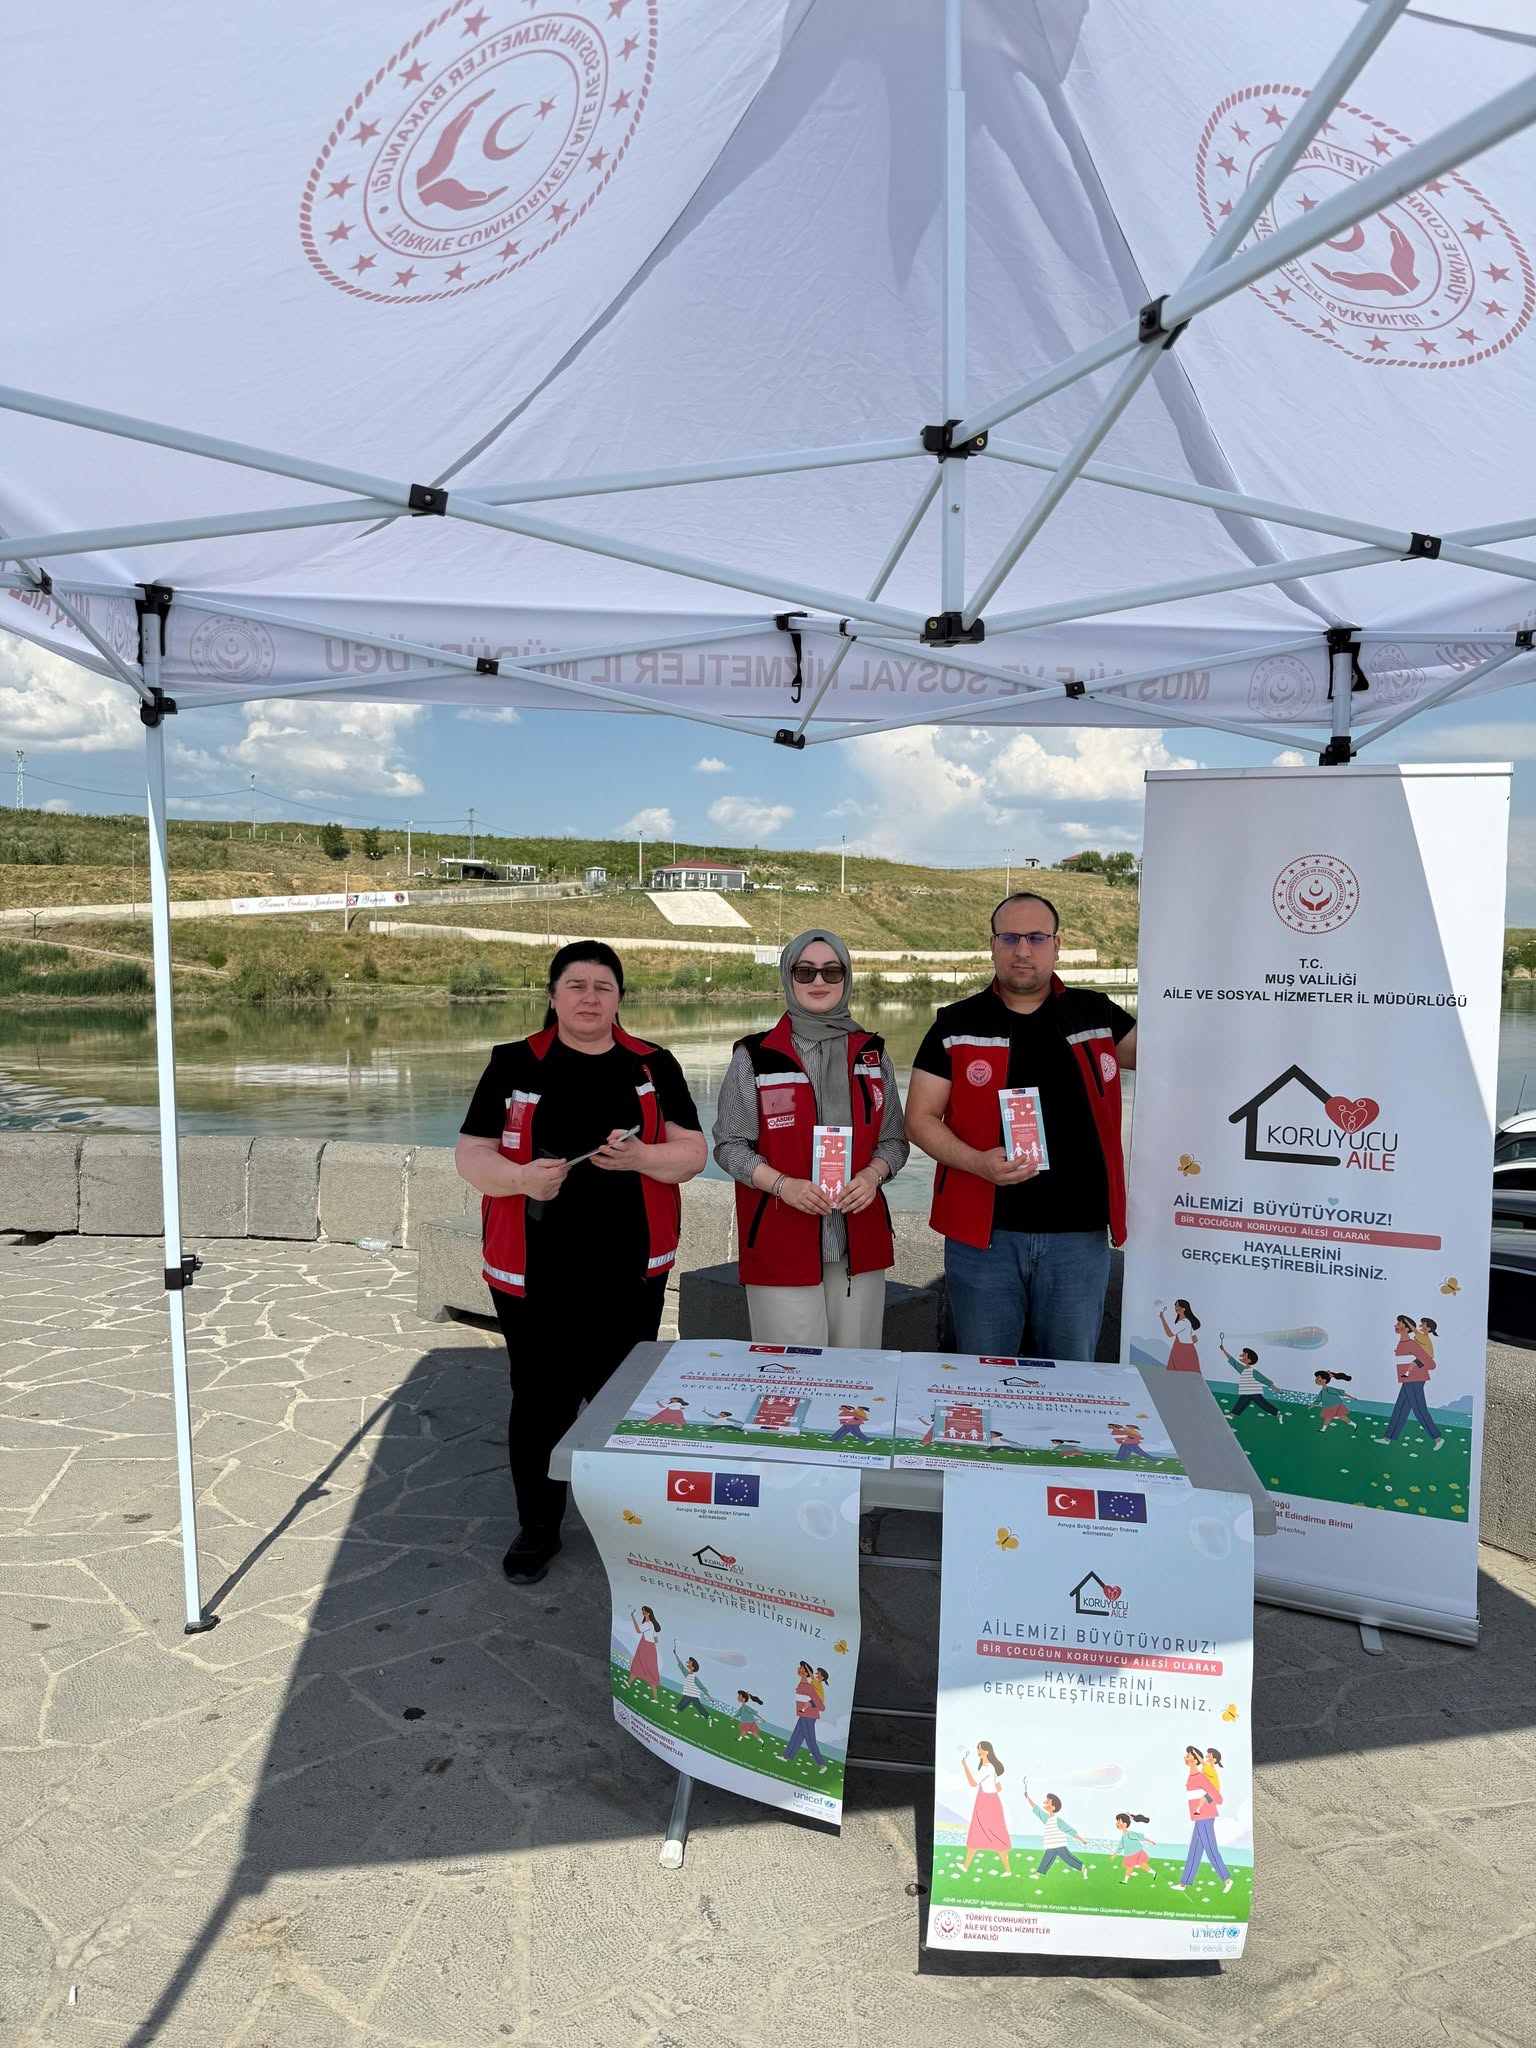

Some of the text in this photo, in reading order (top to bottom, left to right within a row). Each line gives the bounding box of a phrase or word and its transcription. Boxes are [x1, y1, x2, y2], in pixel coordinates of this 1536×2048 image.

[1299, 958, 1323, 970] T.C.
[1265, 972, 1357, 987] MUŞ VALİLİĞİ
[1163, 988, 1468, 1008] AİLE VE SOSYAL HİZMETLER İL MÜDÜRLÜĞÜ
[1267, 1125, 1399, 1152] KORUYUCU
[1346, 1147, 1396, 1172] AİLE
[1173, 1192, 1393, 1227] AİLEMİZİ BÜYÜTÜYORUZ!
[1180, 1214, 1370, 1241] BİR ÇOCUĞUN KORUYUCU AİLESİ OLARAK
[1243, 1240, 1342, 1262] HAYALLERİNİ
[1181, 1247, 1388, 1282] GERÇEKLEŞTİREBİLİRSİNİZ.
[1285, 1511, 1327, 1525] Edindirme
[1328, 1519, 1353, 1530] Birimi
[628, 1551, 827, 1606] AİLEMİZİ BÜYÜTÜYORUZ!
[686, 1582, 777, 1611] HAYALLERİNİ
[1083, 1597, 1128, 1610] KORUYUCU
[790, 1600, 830, 1615] OLARAK
[1111, 1608, 1128, 1619] AİLE
[982, 1619, 1217, 1654] AİLEMİZİ BÜYÜTÜYORUZ!
[983, 1642, 1217, 1673] BİR ÇOCUĞUN KORUYUCU AİLESİ OLARAK
[1044, 1670, 1154, 1691] HAYALLERİNİ
[983, 1681, 1212, 1712] GERÇEKLEŞTİREBİLİRSİNİZ.
[793, 1790, 824, 1805] unicef
[964, 1913, 1038, 1925] TÜRKİYE CUMHURİYETİ
[964, 1923, 979, 1931] AİLE
[989, 1925, 1013, 1933] SOSYAL
[1014, 1926, 1051, 1934] HİZMETLER
[963, 1933, 999, 1941] BAKANLIĞI
[1192, 1925, 1227, 1939] unicef
